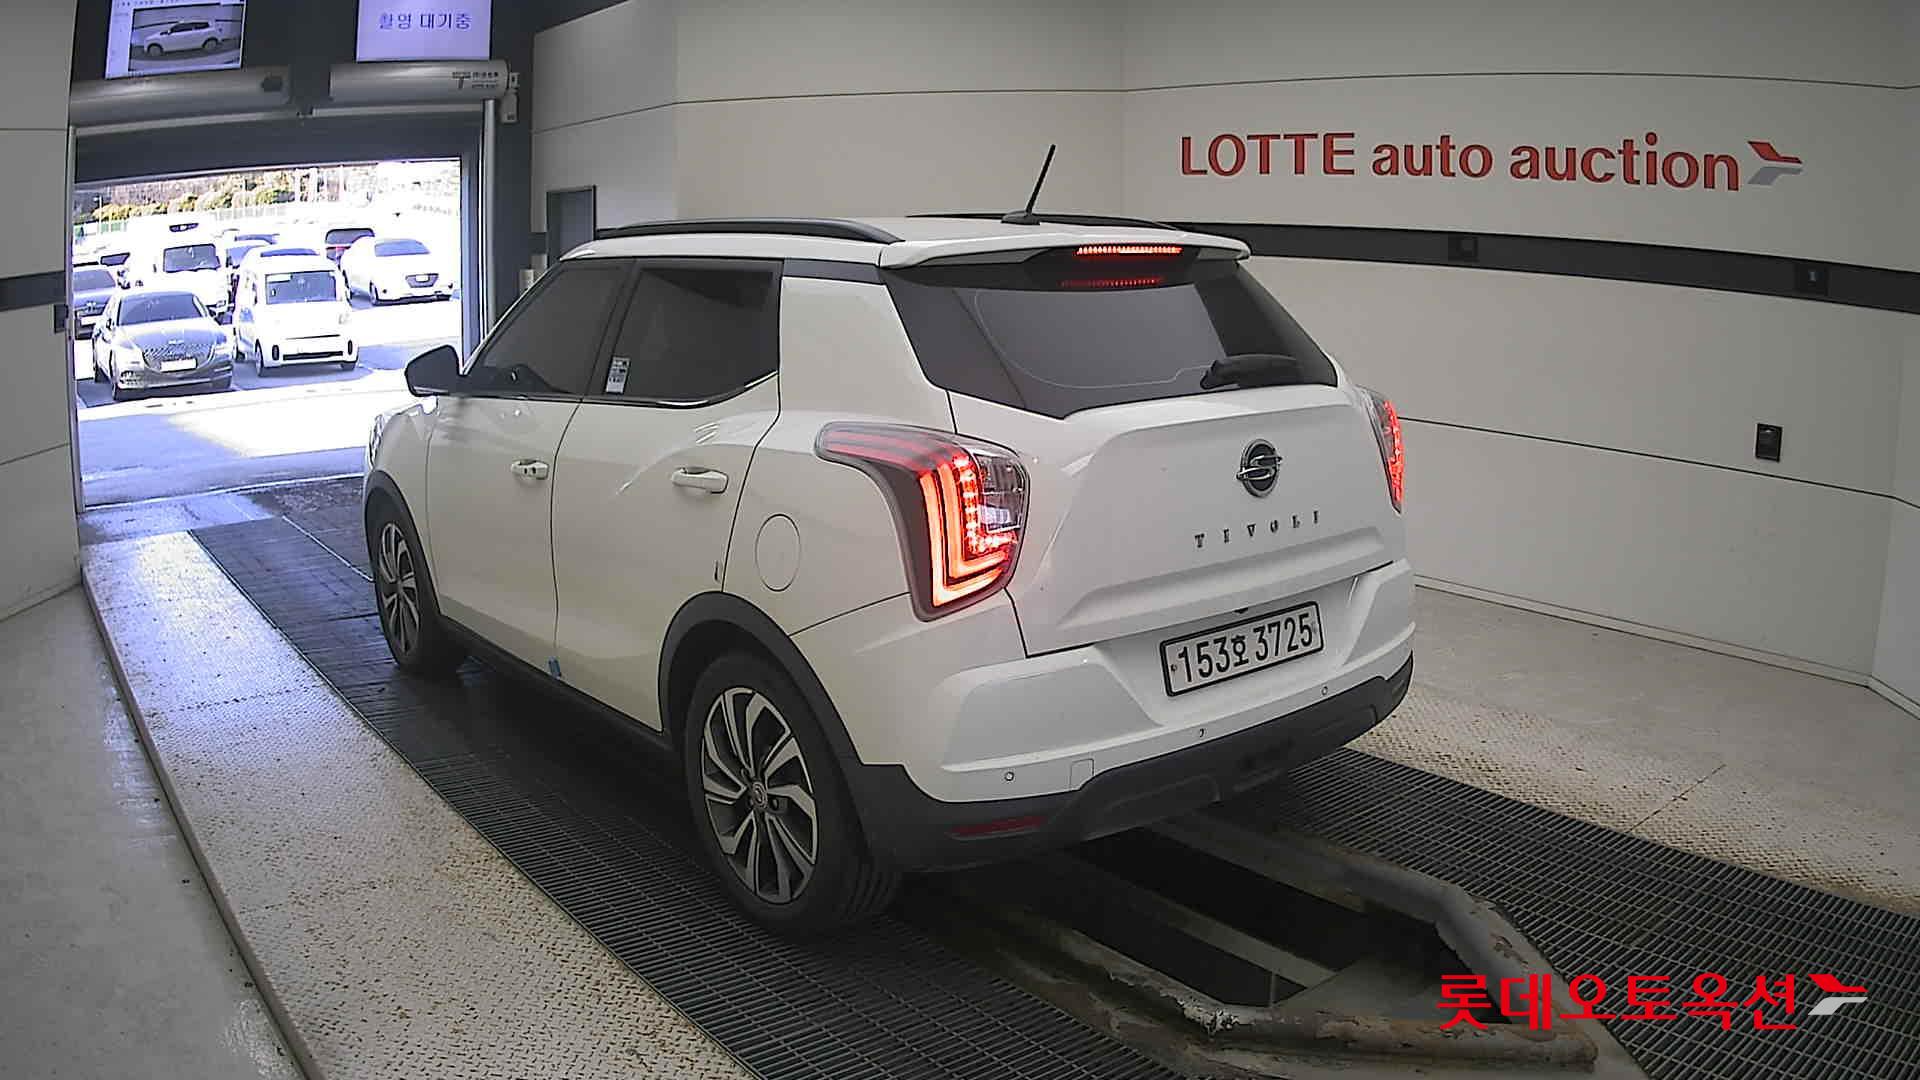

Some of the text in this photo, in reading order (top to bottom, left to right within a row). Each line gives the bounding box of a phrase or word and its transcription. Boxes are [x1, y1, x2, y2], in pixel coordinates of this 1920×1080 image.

[419, 12, 473, 30] 대기중
[1180, 131, 1740, 192] LOTTE auto auction
[1194, 509, 1321, 549] TIVOLI
[1177, 611, 1314, 684] 153호 3725
